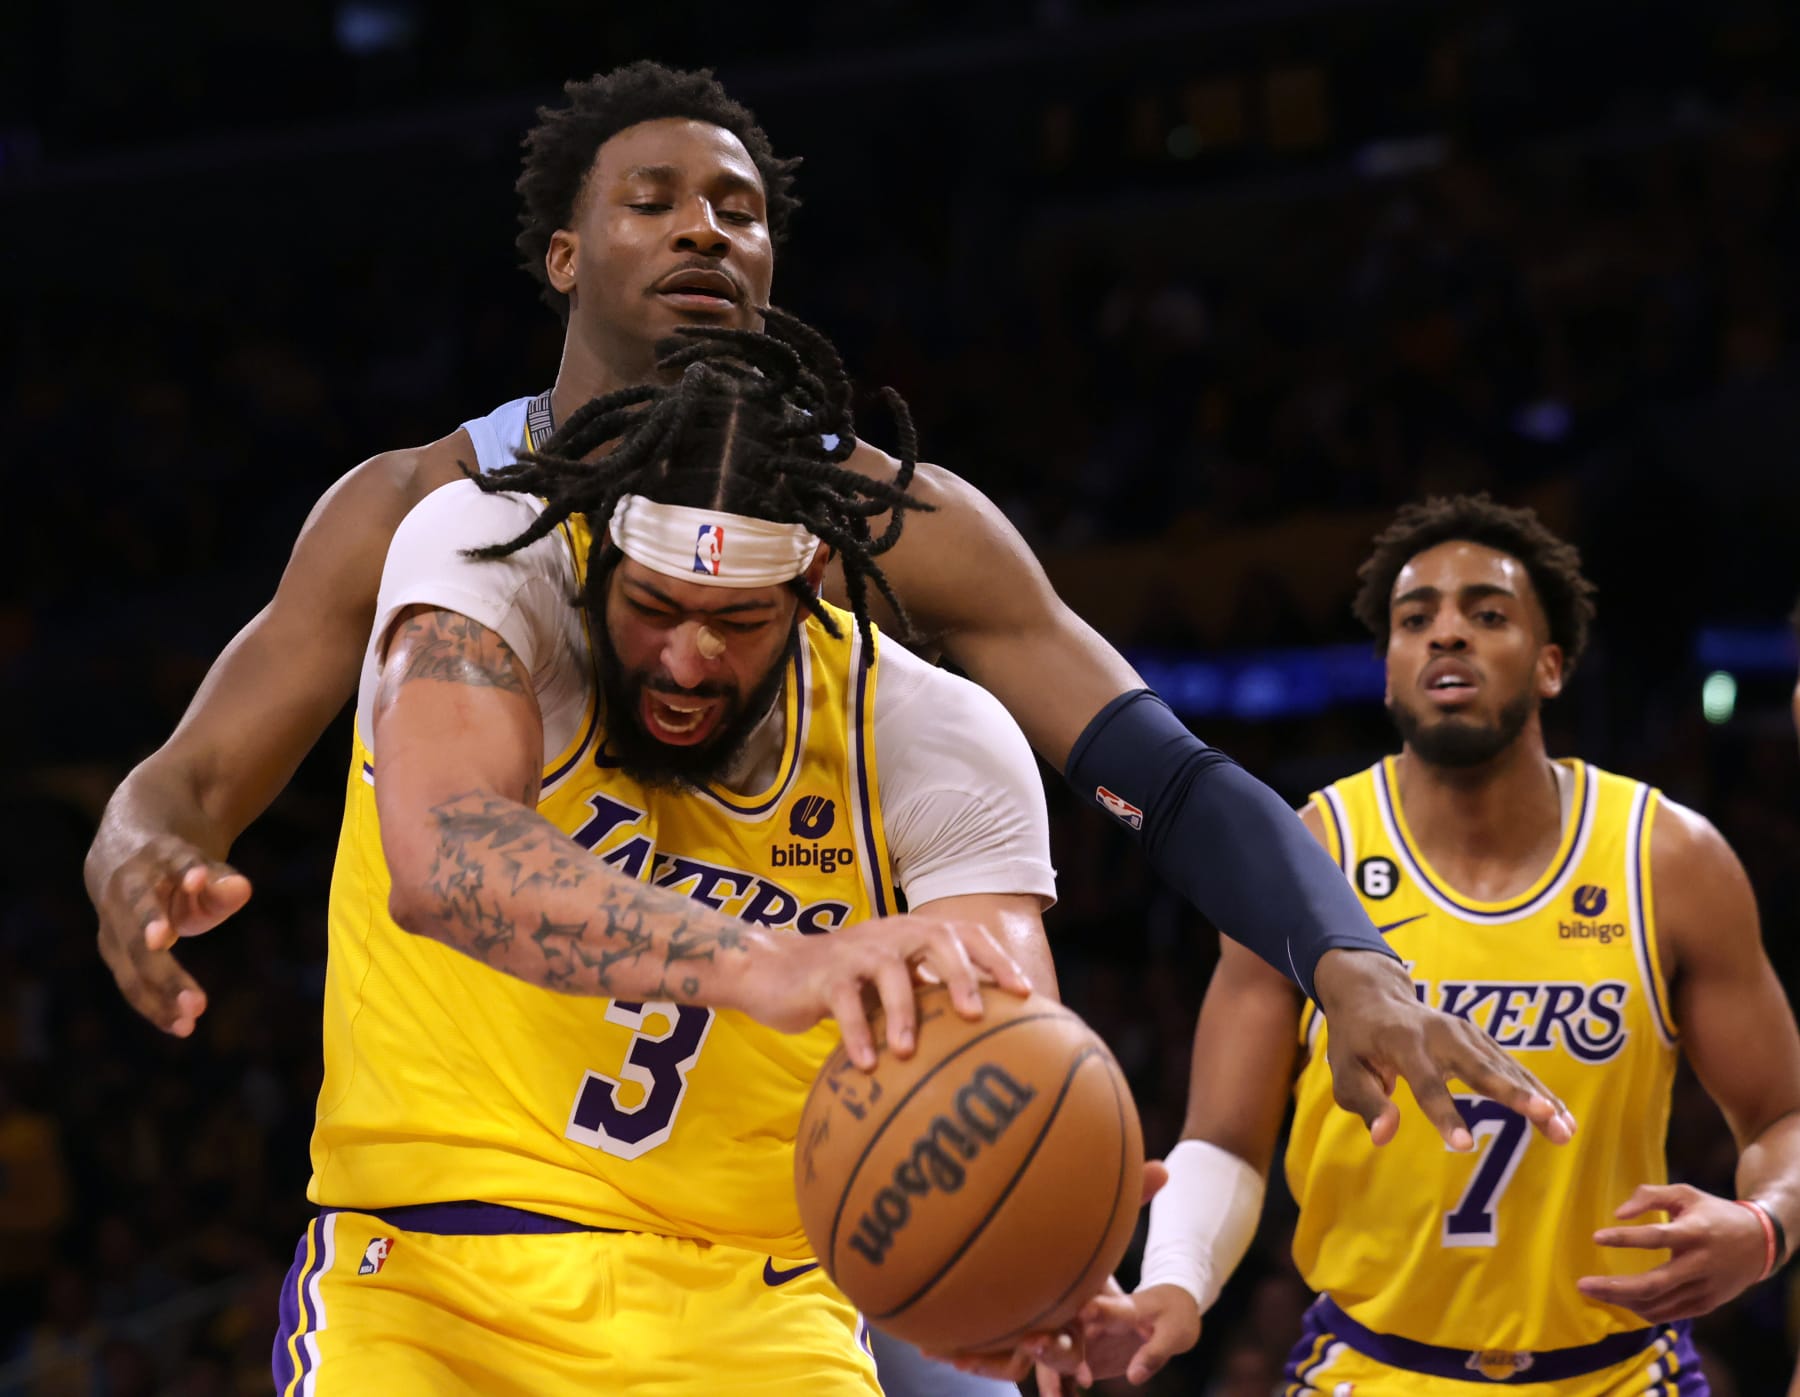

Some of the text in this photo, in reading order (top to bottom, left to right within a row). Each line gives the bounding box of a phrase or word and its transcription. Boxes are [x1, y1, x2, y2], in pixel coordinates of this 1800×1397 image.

[771, 843, 854, 873] bibigo
[1363, 860, 1391, 896] 6
[1558, 921, 1625, 944] bibigo
[1404, 961, 1630, 1065] KERS
[565, 998, 716, 1161] 3
[847, 1062, 1038, 1266] Wilson
[1441, 1093, 1534, 1248] 7
